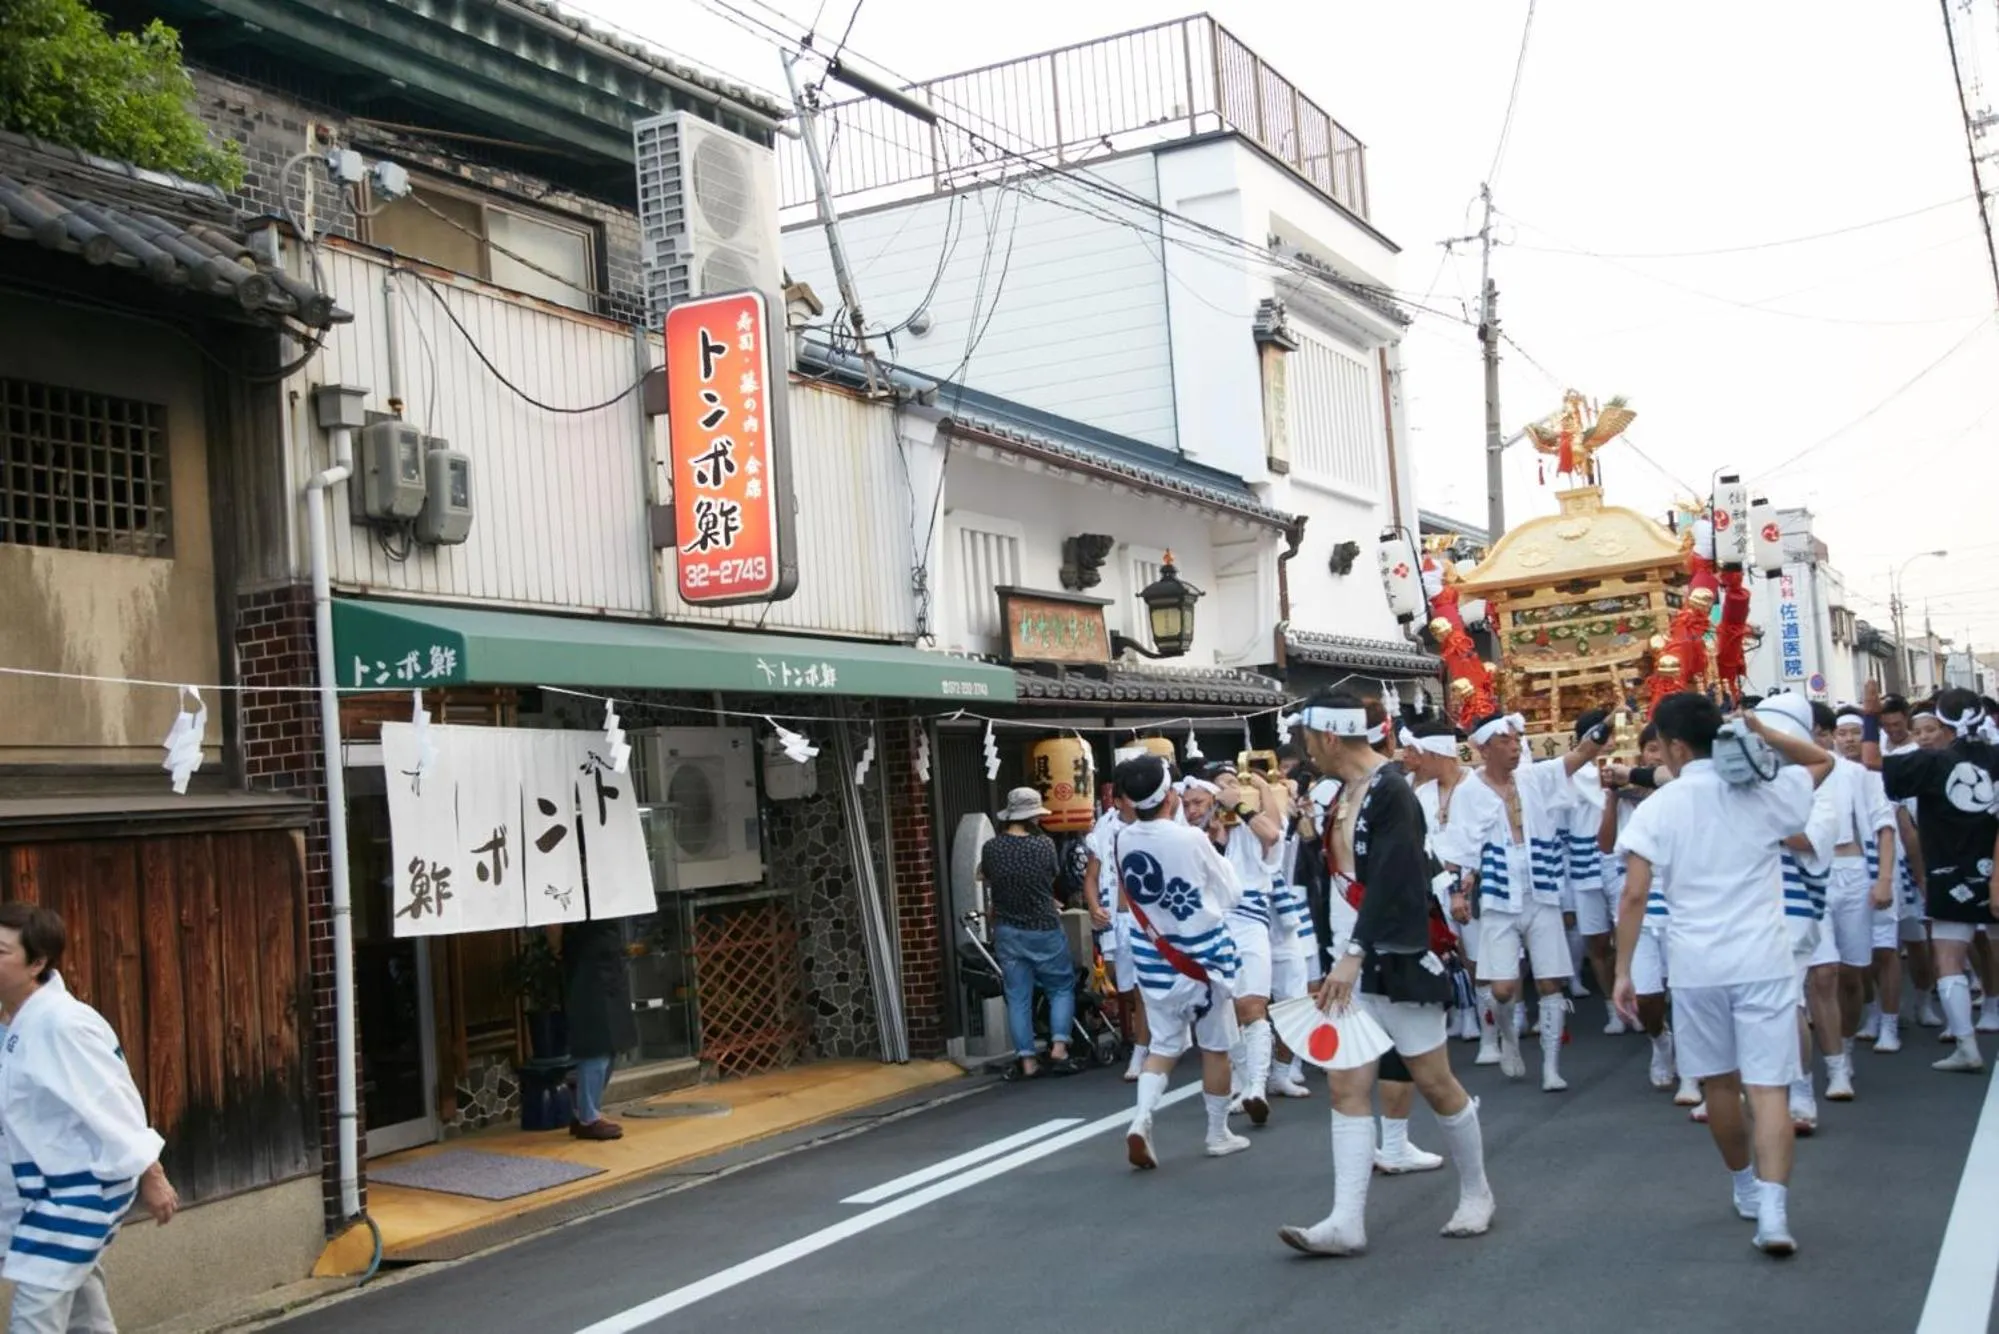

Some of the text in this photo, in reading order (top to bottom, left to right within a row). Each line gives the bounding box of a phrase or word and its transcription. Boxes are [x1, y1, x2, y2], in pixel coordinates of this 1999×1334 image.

[685, 556, 768, 588] 32-2743
[1780, 575, 1794, 600] 内科
[1780, 603, 1803, 677] 佐道医院
